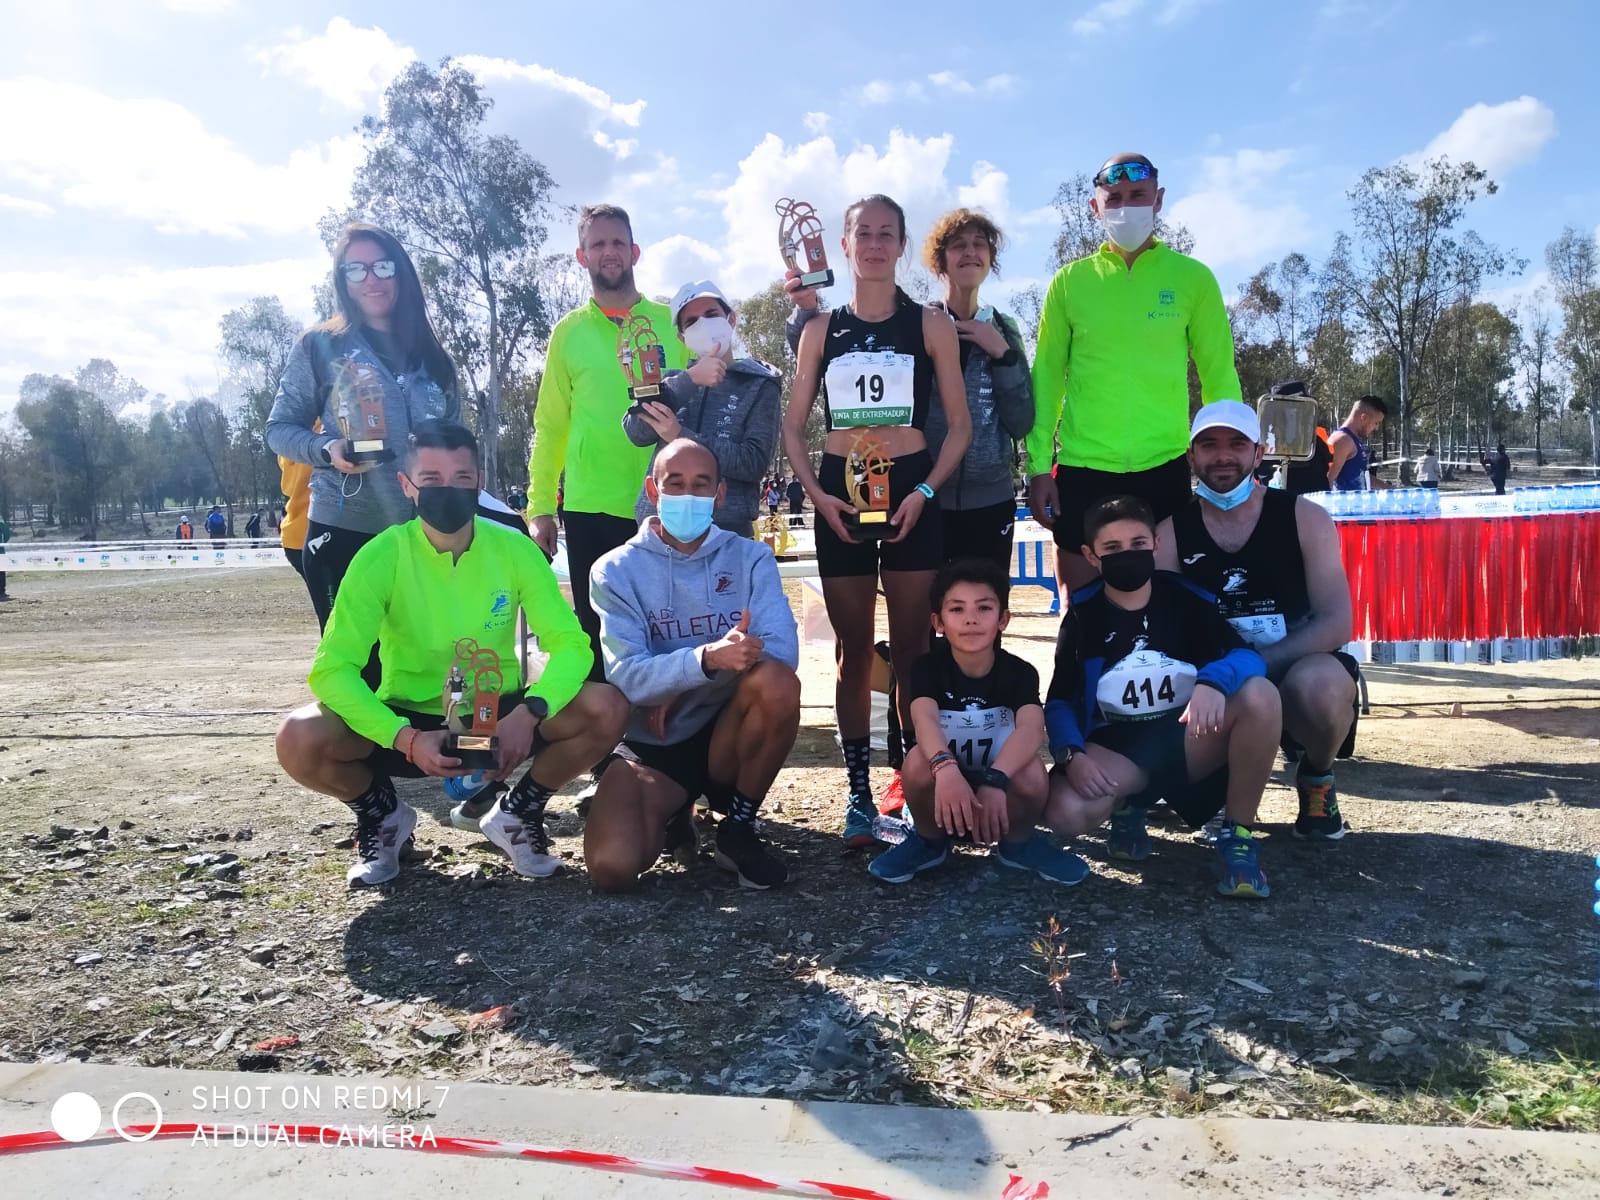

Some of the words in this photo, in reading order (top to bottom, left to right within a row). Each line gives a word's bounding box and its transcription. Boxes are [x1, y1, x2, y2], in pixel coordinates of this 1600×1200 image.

[855, 374, 884, 403] 19
[852, 411, 861, 419] DE
[862, 409, 909, 419] EXTREMADURA
[649, 610, 742, 641] ATLETAS
[1121, 674, 1175, 709] 414
